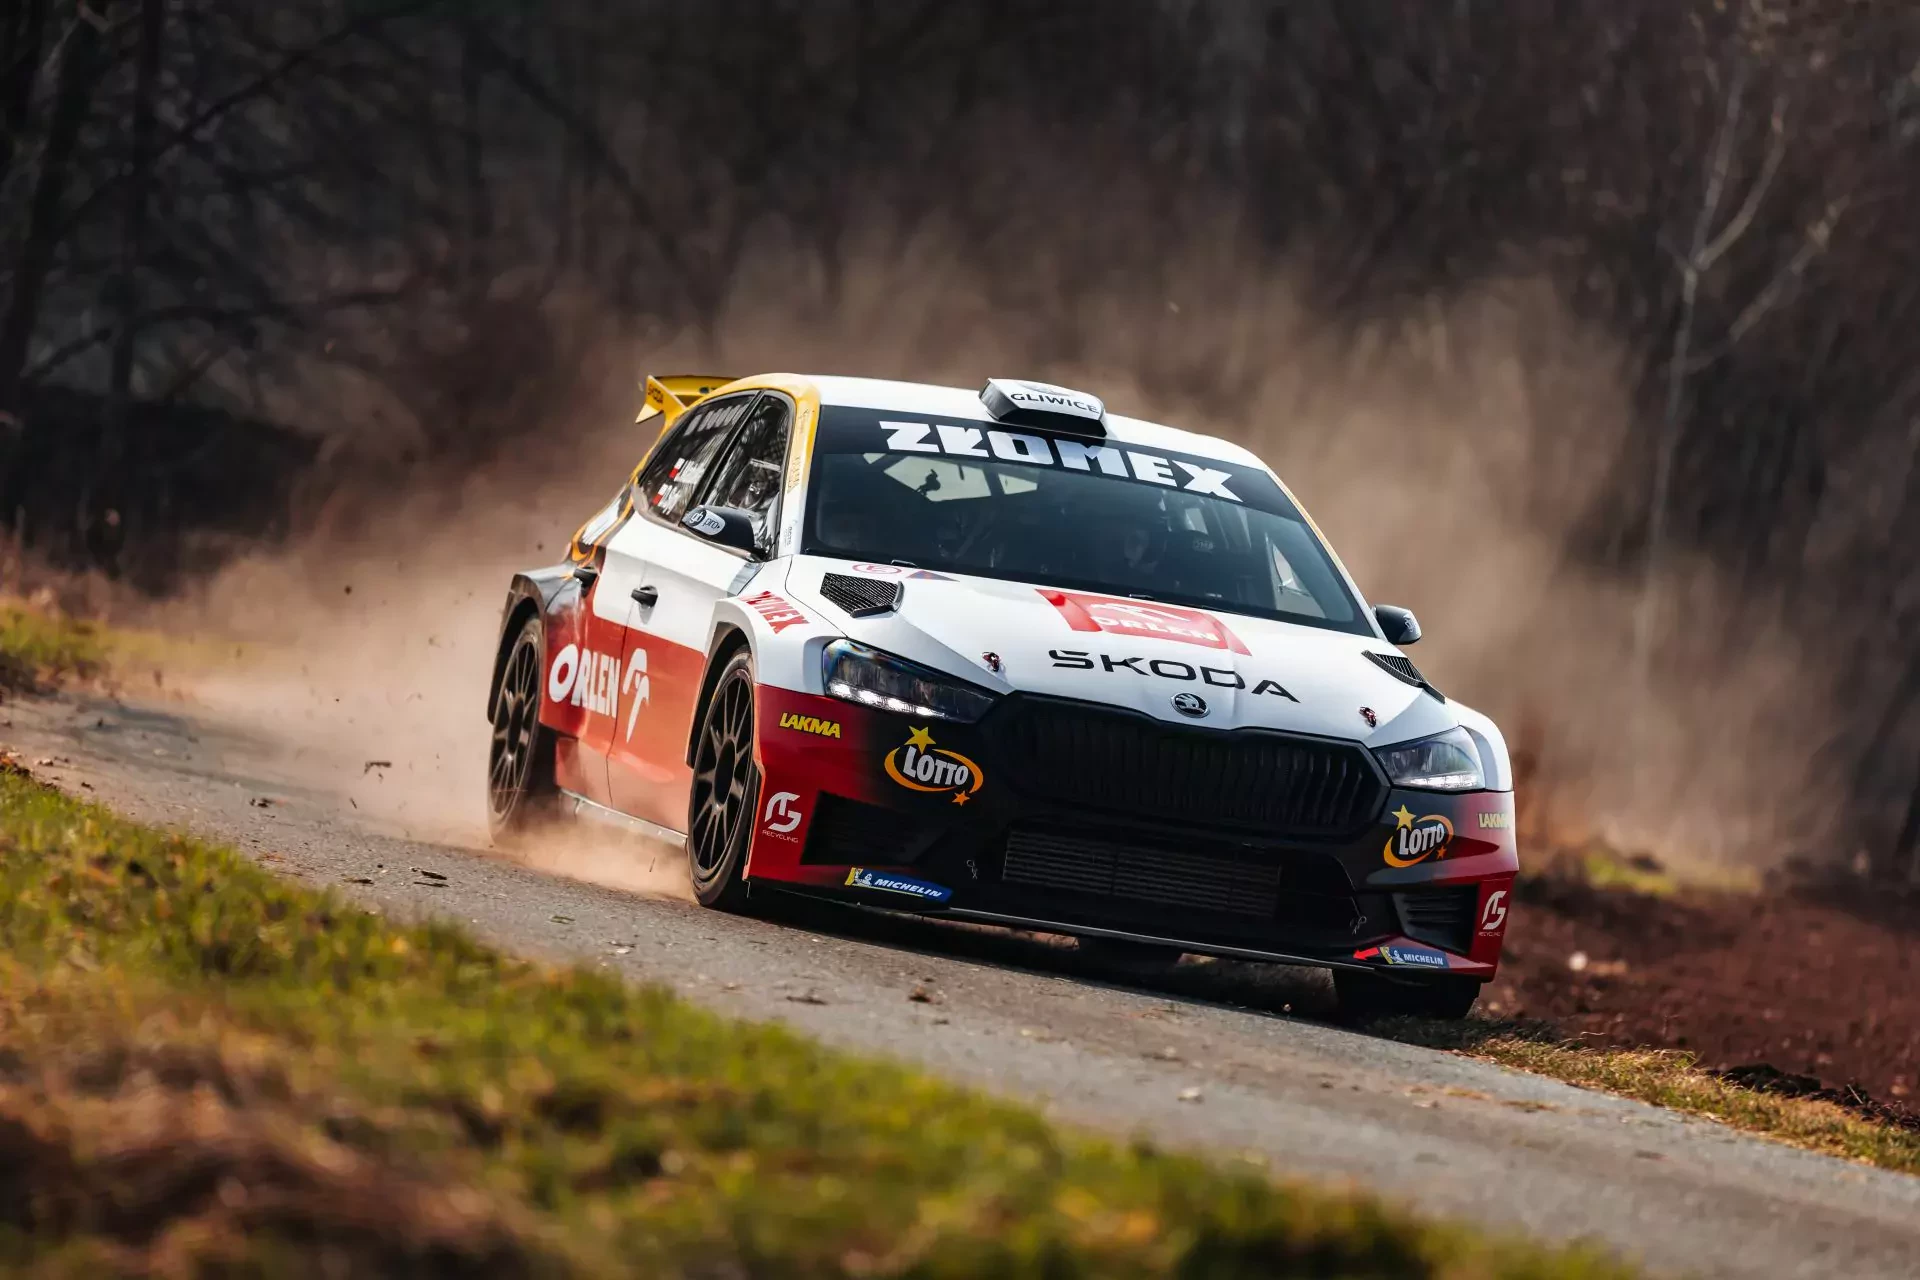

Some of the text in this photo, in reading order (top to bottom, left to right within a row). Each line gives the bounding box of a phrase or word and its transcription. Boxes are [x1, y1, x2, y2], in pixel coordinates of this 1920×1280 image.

[1010, 393, 1100, 414] GLIWICE
[879, 420, 1244, 502] ZKOMEX
[1090, 615, 1220, 641] ORLEN
[548, 643, 621, 719] ORLEN
[779, 712, 842, 738] LAKMA
[762, 829, 799, 843] RECYCLING
[874, 878, 943, 897] MICHELIN
[1403, 953, 1444, 965] MICHELIN
